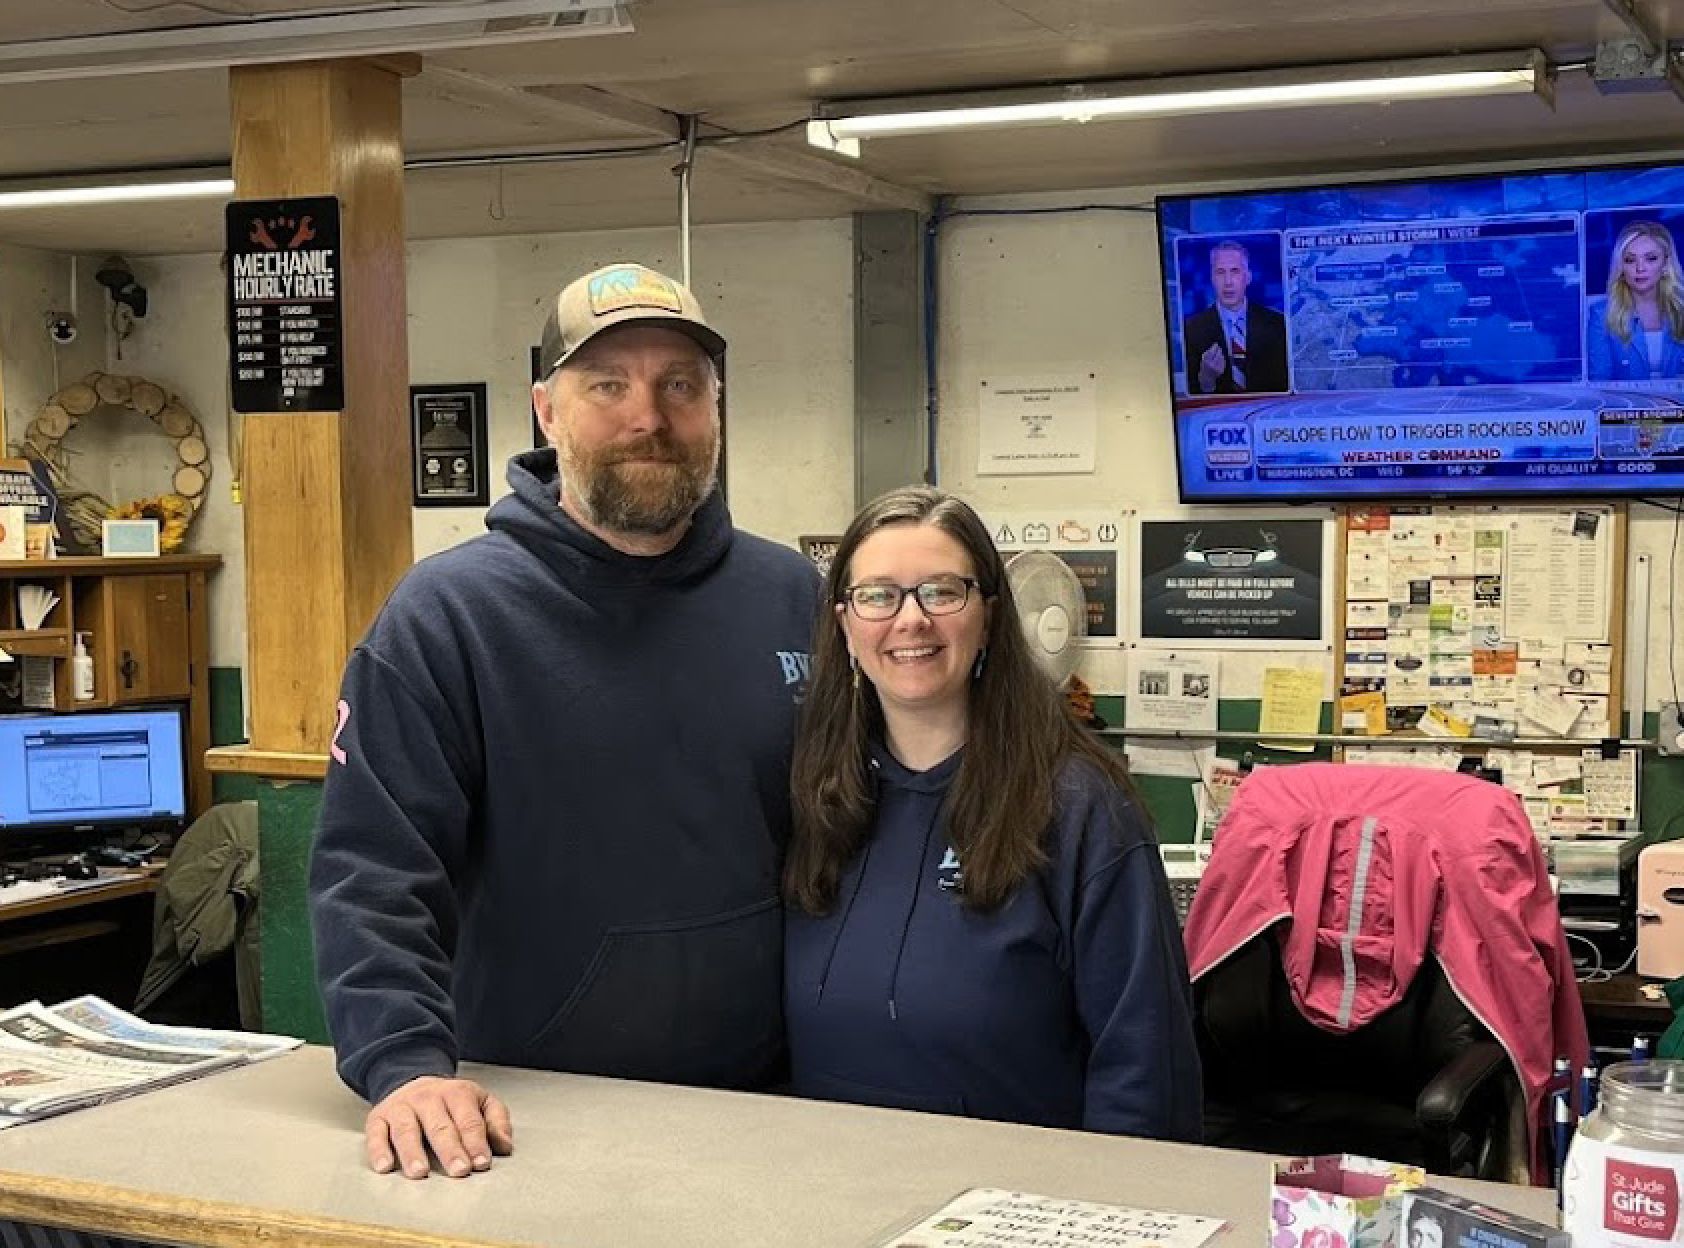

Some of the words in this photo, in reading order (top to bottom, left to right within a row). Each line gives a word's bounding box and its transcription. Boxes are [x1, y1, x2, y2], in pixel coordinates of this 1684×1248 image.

[234, 250, 334, 276] MECHANIC
[234, 275, 292, 300] HOURLY
[294, 273, 335, 297] RATE
[1207, 428, 1248, 446] FOX
[1263, 427, 1327, 443] UPSLOPE
[1331, 426, 1373, 441] FLOW
[1376, 425, 1397, 440] TO
[1402, 423, 1465, 440] TRIGGER
[1468, 420, 1533, 438] ROCKIES
[1537, 419, 1586, 436] SNOW
[1342, 450, 1413, 462] WEATHER
[1418, 447, 1501, 461] COMMAND
[1214, 469, 1244, 481] LIVE
[1548, 463, 1599, 474] QUALITY
[1617, 462, 1656, 473] GOOD
[1630, 1176, 1666, 1195] Jude
[1611, 1189, 1667, 1217] Gifts
[976, 1208, 1059, 1224] MORE
[1086, 1223, 1170, 1240] SHOW
[990, 1200, 1098, 1219] DONATE
[1138, 1219, 1178, 1231] OR
[1612, 1209, 1637, 1227] That
[1638, 1215, 1666, 1231] Give
[993, 1222, 1049, 1233] OFF
[1054, 1230, 1128, 1247] YOUR
